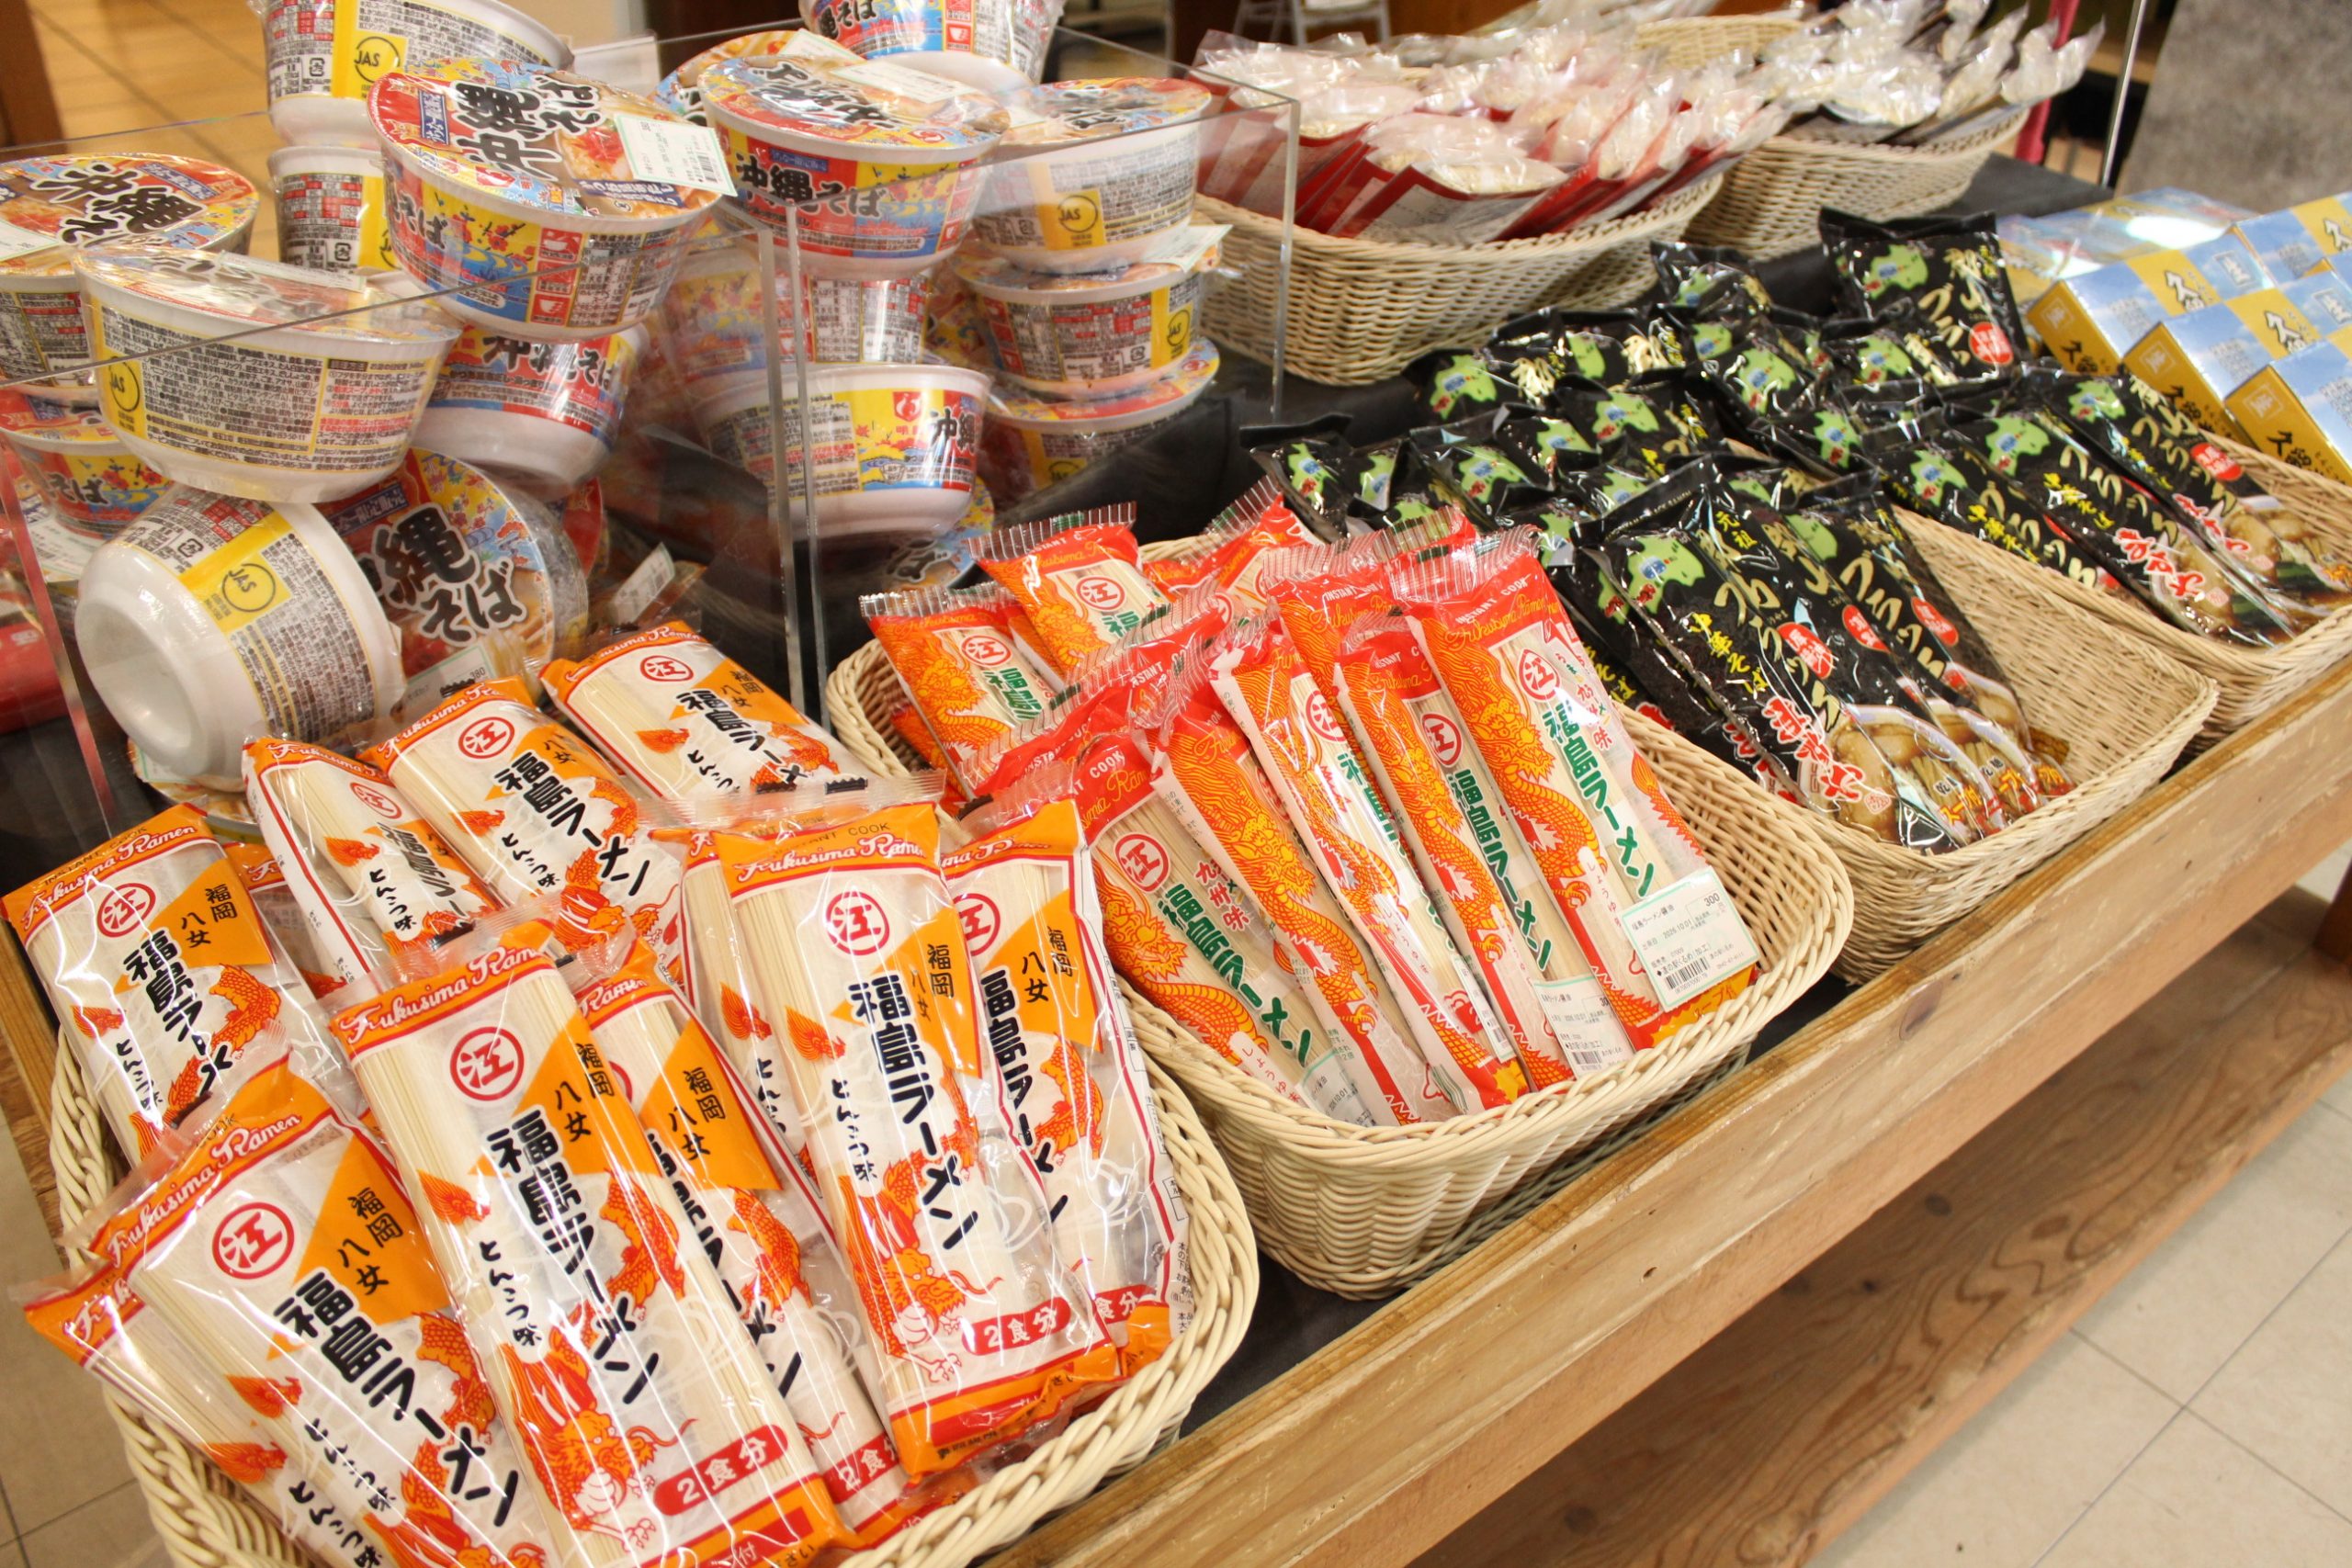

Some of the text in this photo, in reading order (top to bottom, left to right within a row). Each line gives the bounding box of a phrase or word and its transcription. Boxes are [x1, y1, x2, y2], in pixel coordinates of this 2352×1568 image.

[355, 50, 381, 68] JAS
[1058, 208, 1081, 222] JAS
[1917, 282, 1972, 367] ブラッ
[108, 372, 126, 394] JAS
[1716, 510, 1758, 549] 元祖
[228, 567, 258, 593] JAS
[420, 560, 525, 642] そば
[1690, 611, 1769, 694] 中華そば
[674, 689, 808, 784] 福島ラーメ
[494, 751, 651, 897] 福島ラーメン
[501, 832, 567, 889] とんこつ味
[1447, 768, 1552, 971] 福島ラーメン
[181, 911, 212, 950] 八女
[205, 883, 239, 923] 福岡
[1703, 892, 1721, 908] 300
[927, 943, 956, 999] 福岡
[1157, 883, 1312, 1066] 福島ラーメン
[122, 929, 233, 1096] 福島ラーメ
[340, 978, 468, 1044] Fukusima
[576, 1040, 616, 1100] 福岡
[683, 1066, 727, 1122] 福岡
[552, 1078, 594, 1144] 八女
[669, 1109, 711, 1161] 八女
[831, 1078, 877, 1182] とんこつ味
[847, 974, 980, 1250] 福島ラーメン
[347, 1186, 404, 1249] 福岡
[336, 1236, 390, 1296] 八女
[485, 1108, 661, 1405] 福島ラーメン
[479, 1238, 543, 1350] とんこつ味
[982, 1304, 1058, 1349] 2食分
[273, 1271, 519, 1528] 福島ラーメン
[304, 1418, 398, 1513] とんこつ味
[675, 1437, 770, 1505] 2食分
[288, 1480, 384, 1568] とんこつ味
